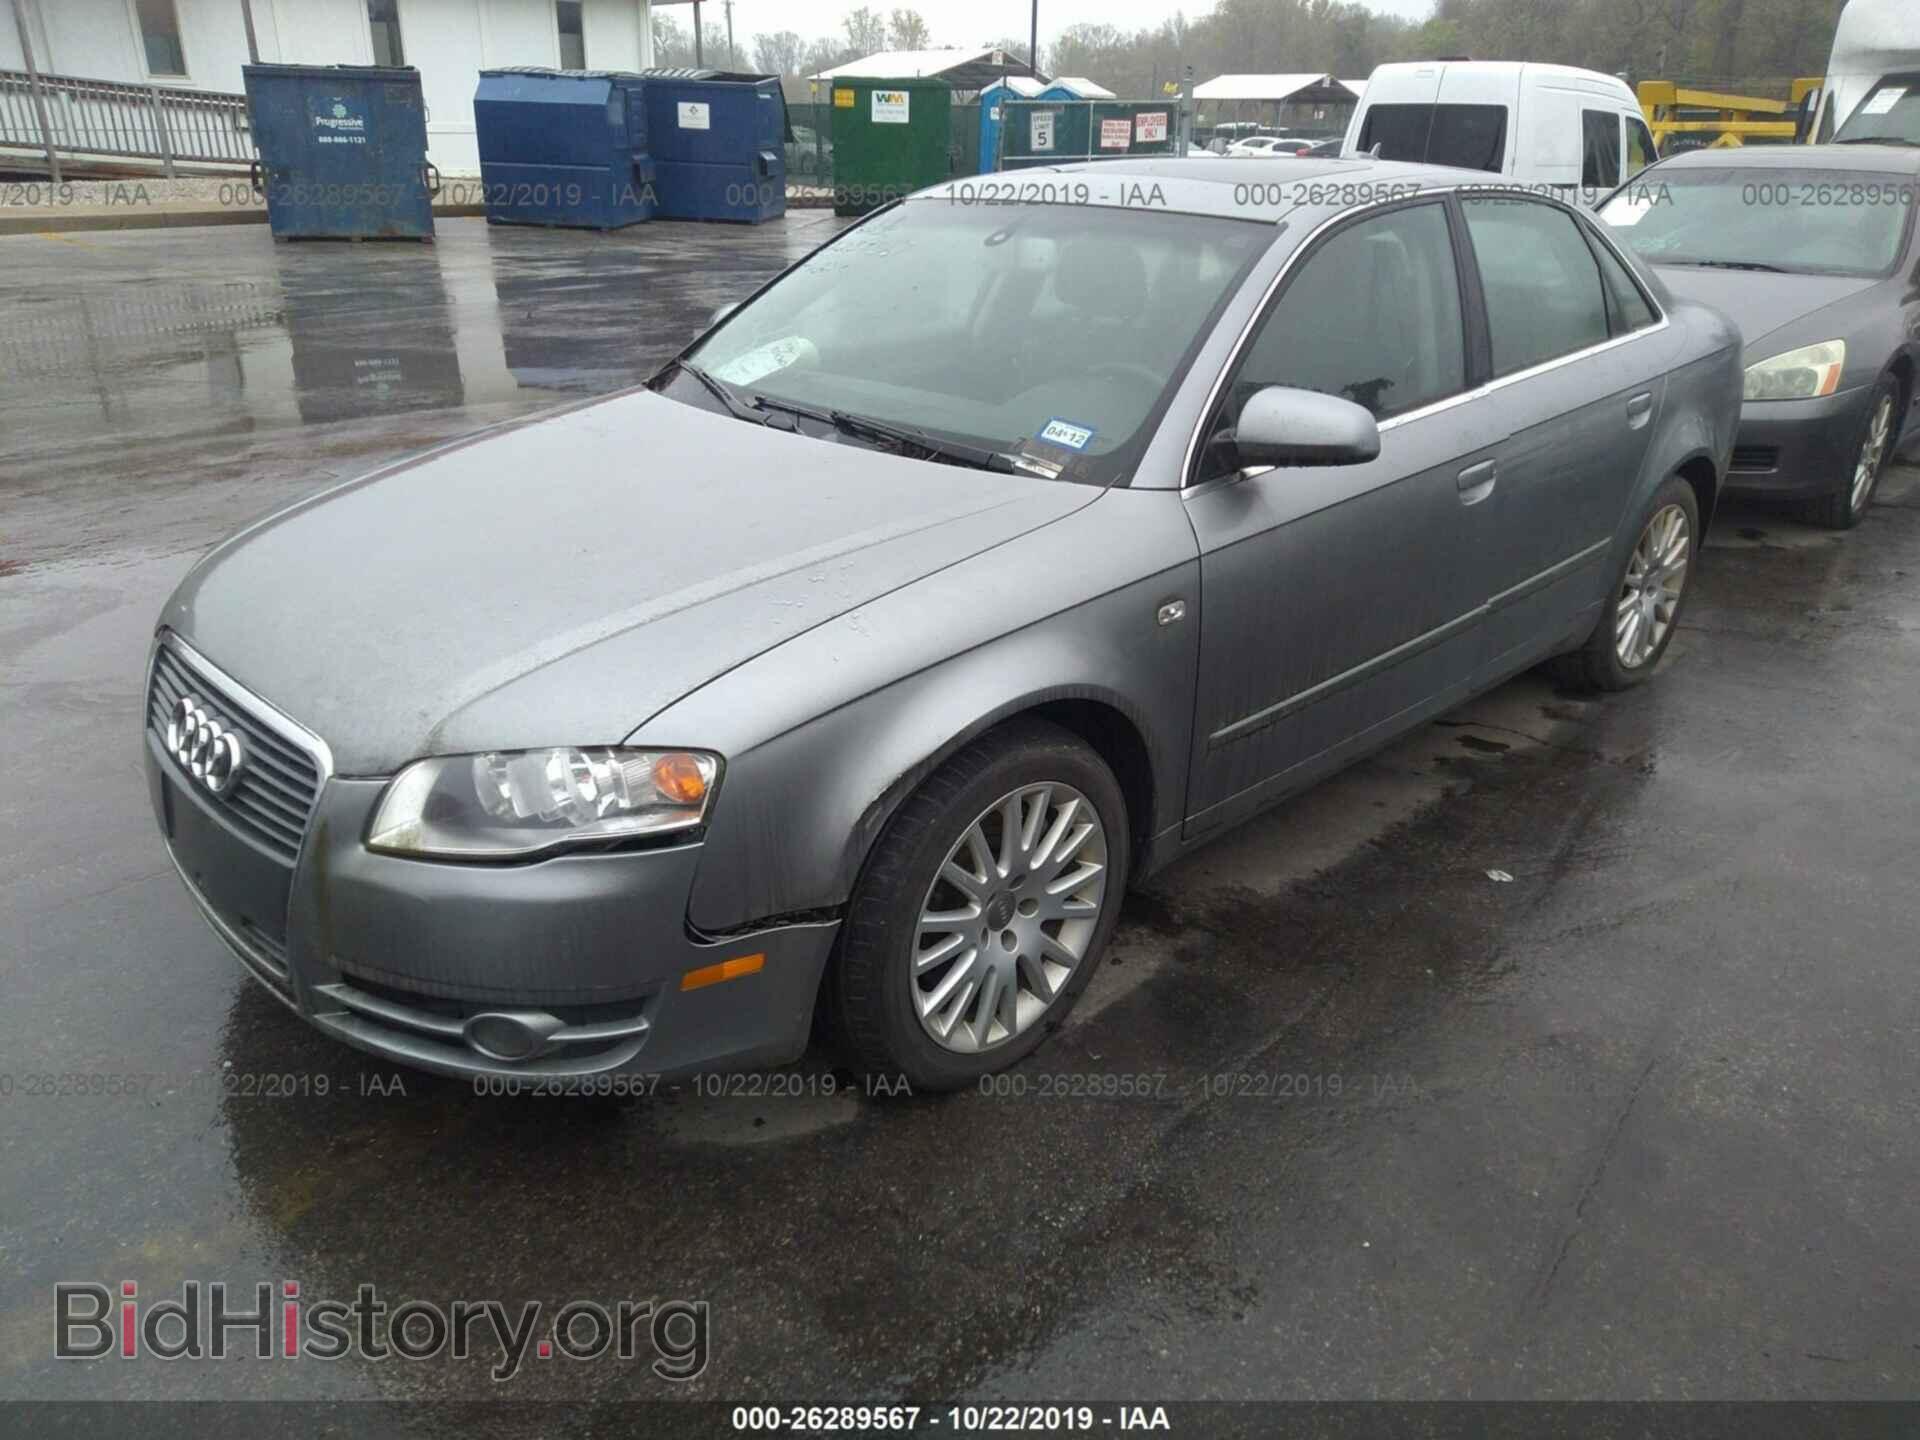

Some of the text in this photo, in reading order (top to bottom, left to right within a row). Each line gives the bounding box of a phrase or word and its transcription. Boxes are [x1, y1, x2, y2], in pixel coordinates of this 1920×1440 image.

[876, 93, 904, 104] WM
[315, 116, 364, 129] Progressive
[1038, 131, 1047, 146] 5
